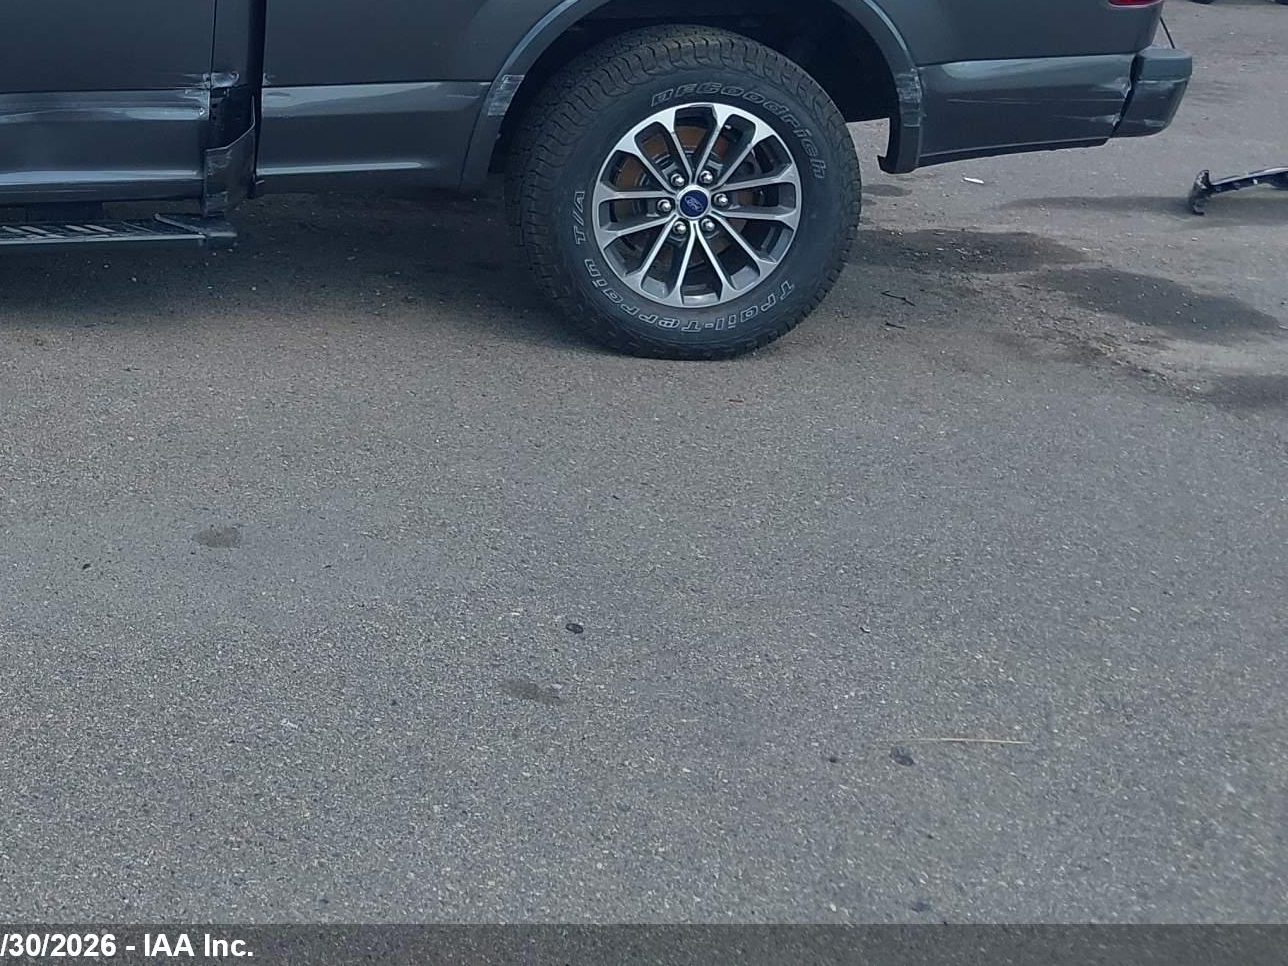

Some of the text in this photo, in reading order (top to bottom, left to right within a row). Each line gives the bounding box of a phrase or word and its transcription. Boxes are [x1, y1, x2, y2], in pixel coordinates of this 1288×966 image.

[651, 82, 827, 179] BFGoodrich
[573, 191, 795, 333] Trail-Terrain T/A
